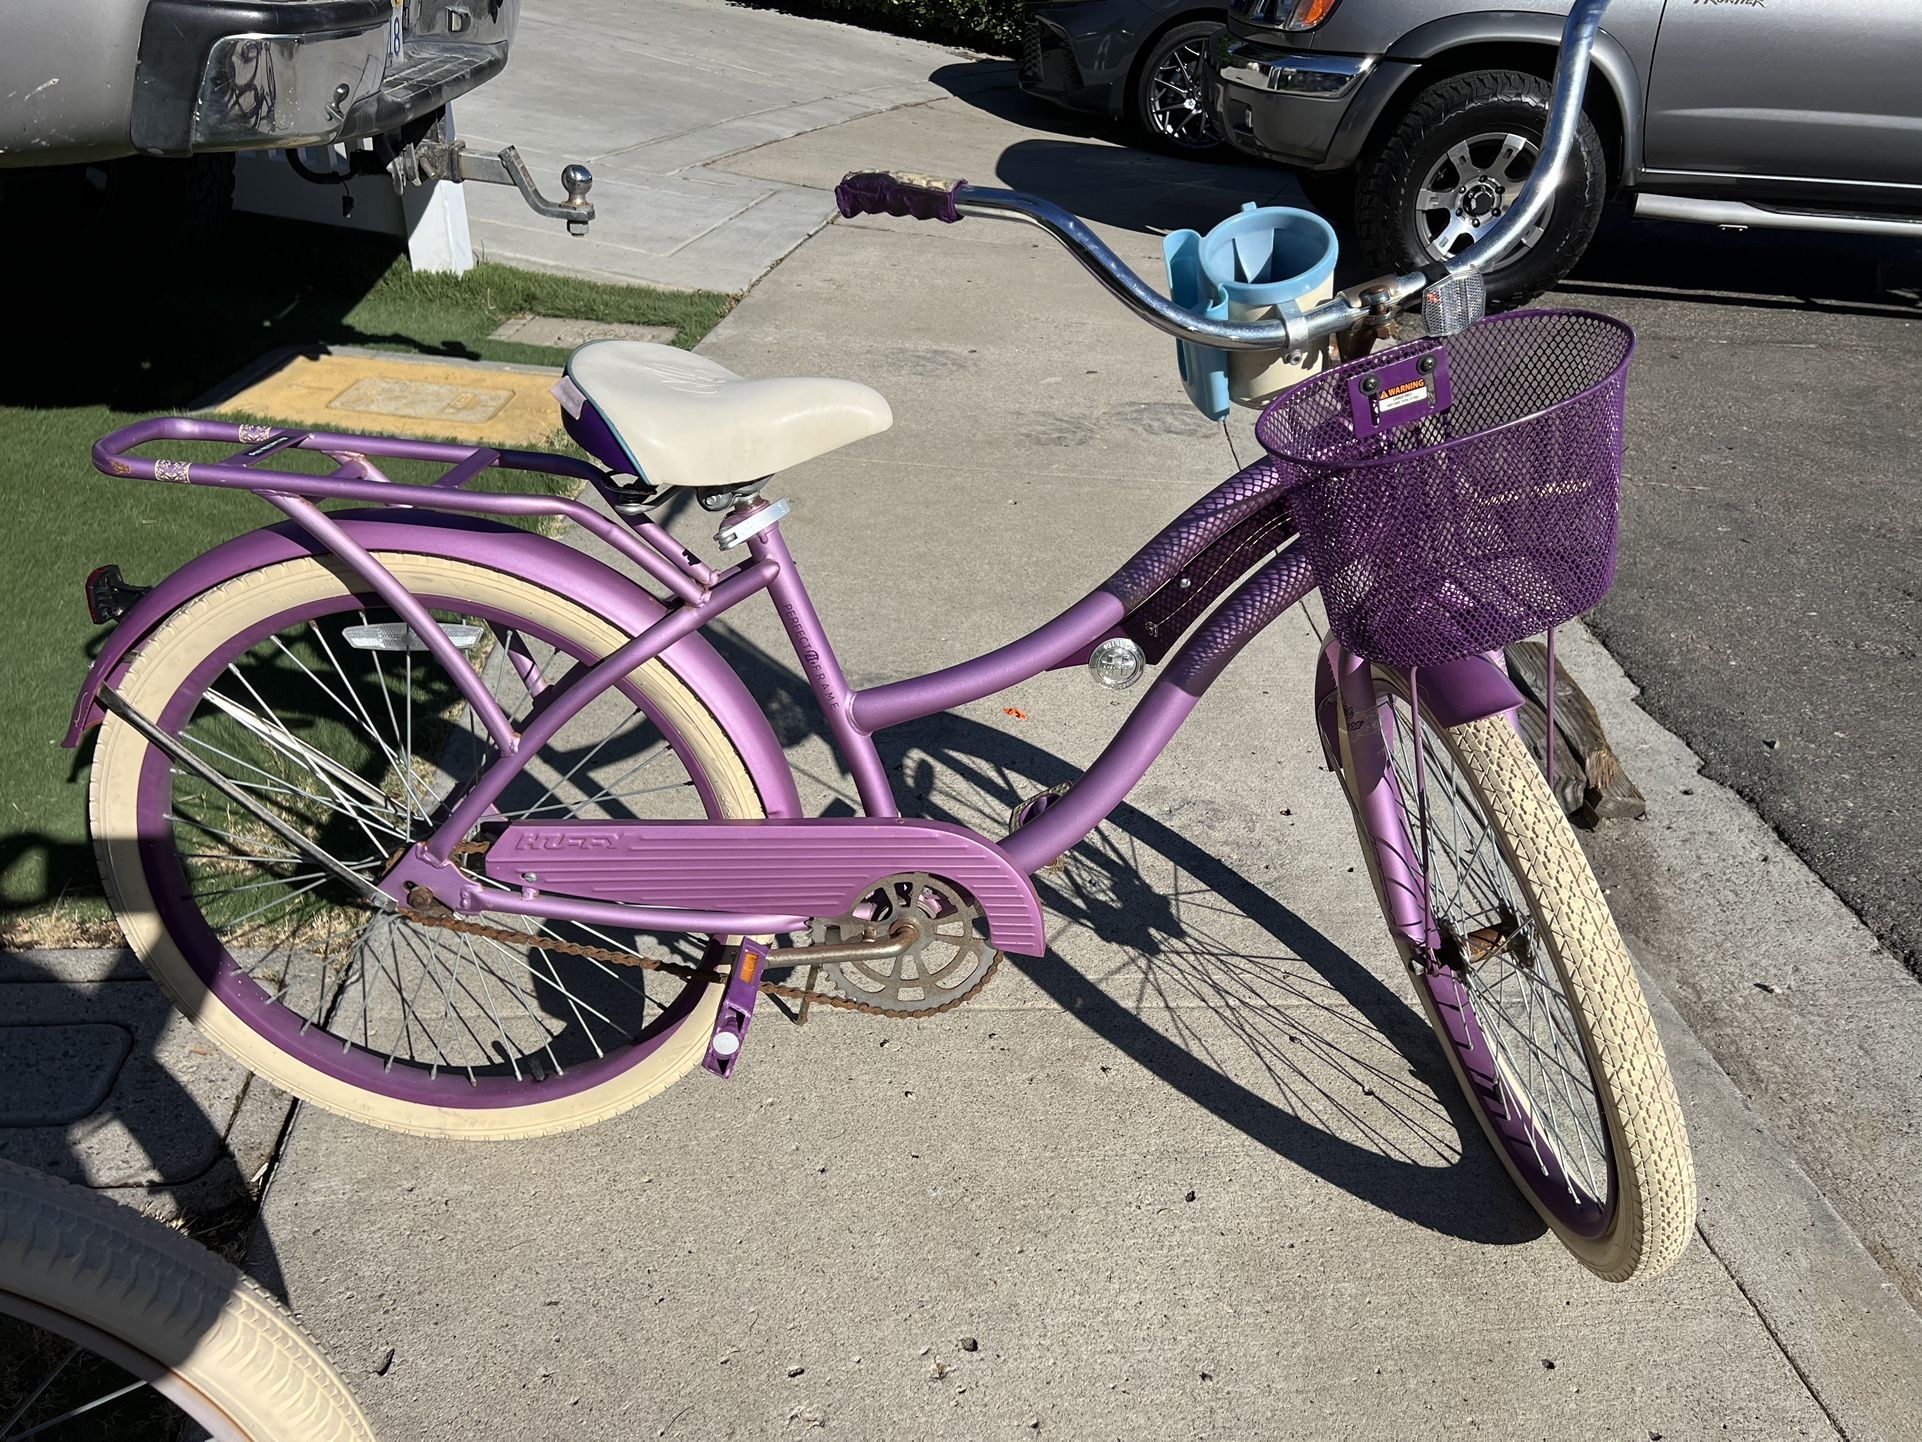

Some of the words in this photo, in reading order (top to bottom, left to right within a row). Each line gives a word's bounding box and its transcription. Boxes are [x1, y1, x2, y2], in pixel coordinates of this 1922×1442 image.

[1388, 378, 1425, 397] WARNING
[783, 603, 812, 653] PERFECT
[814, 663, 840, 710] FRAME
[515, 831, 620, 851] HUFFY
